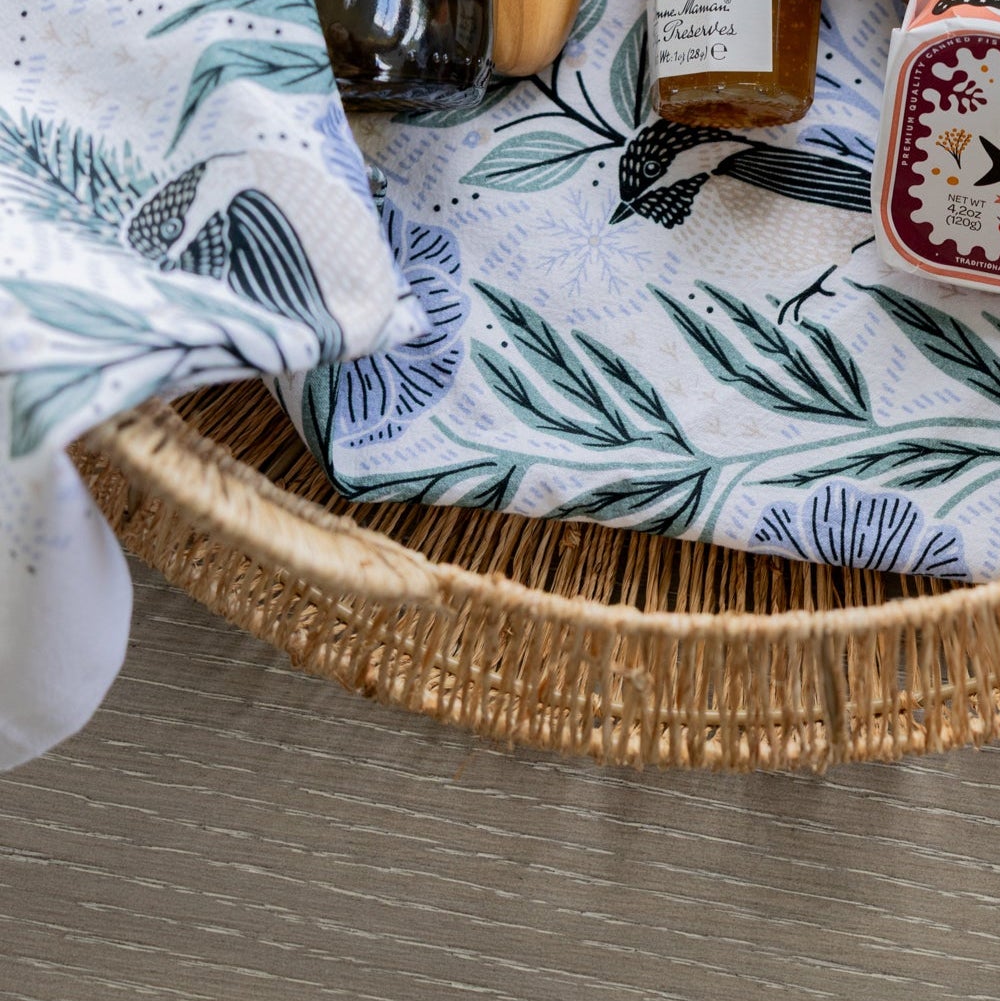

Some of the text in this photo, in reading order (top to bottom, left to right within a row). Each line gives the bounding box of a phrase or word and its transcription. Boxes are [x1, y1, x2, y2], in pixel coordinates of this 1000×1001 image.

[663, 19, 737, 42] Preserves
[925, 36, 971, 59] CANNED
[901, 62, 926, 166] PREMIUM QUALITY
[947, 193, 987, 209] NET WT
[947, 205, 983, 220] 4,2oz
[945, 215, 982, 232] (120g)
